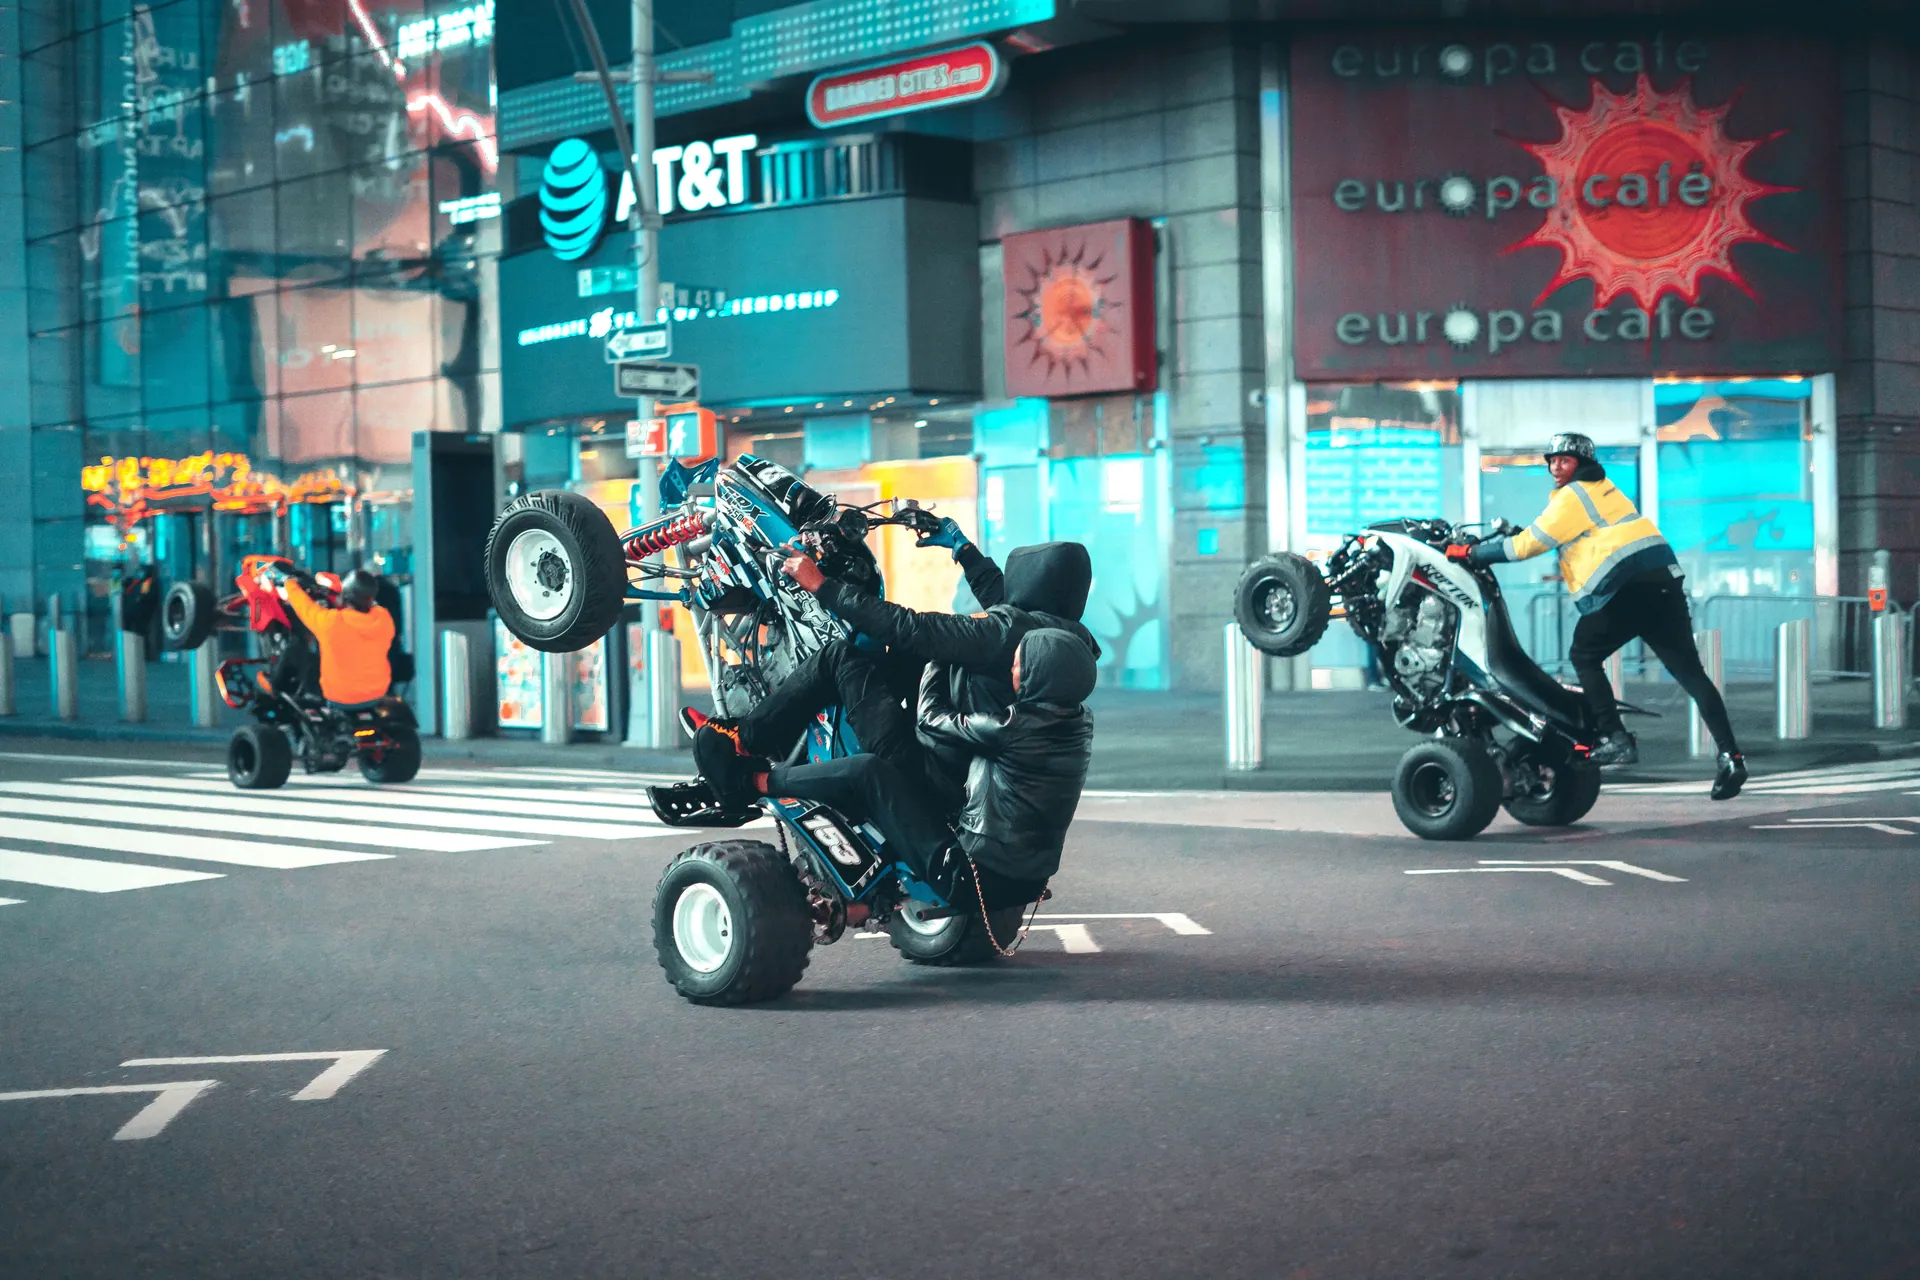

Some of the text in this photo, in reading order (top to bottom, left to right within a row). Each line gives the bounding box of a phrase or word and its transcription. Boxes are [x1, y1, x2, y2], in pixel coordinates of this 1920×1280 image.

[1331, 41, 1557, 85] europa
[614, 133, 757, 222] AT&T
[1333, 178, 1558, 218] europa
[1335, 312, 1563, 353] europa
[721, 487, 770, 521] TRX
[1422, 563, 1478, 609] RAPTOR
[803, 814, 861, 865] 153
